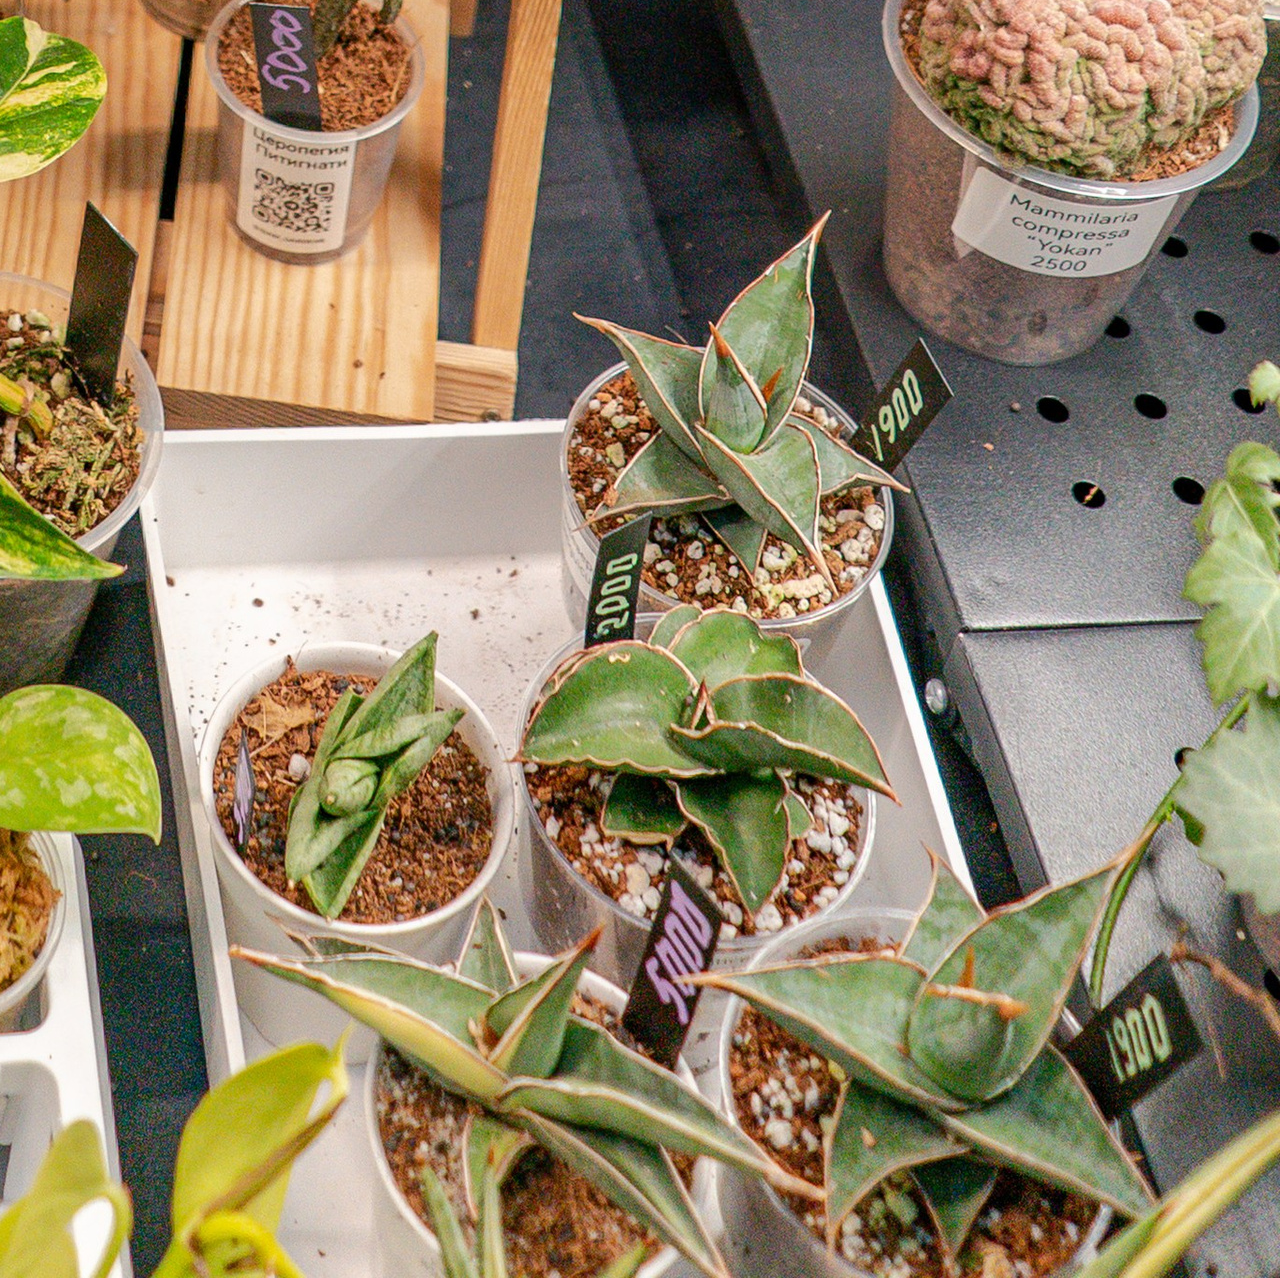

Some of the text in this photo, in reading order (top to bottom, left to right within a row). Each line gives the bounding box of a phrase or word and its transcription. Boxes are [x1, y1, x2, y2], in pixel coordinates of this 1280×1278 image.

[261, 8, 312, 94] 5000
[1009, 194, 1139, 225] Mammilaria
[1011, 216, 1130, 241] compressa
[1030, 255, 1087, 272] 2500
[865, 368, 924, 462] 1900
[594, 552, 639, 639] 2000
